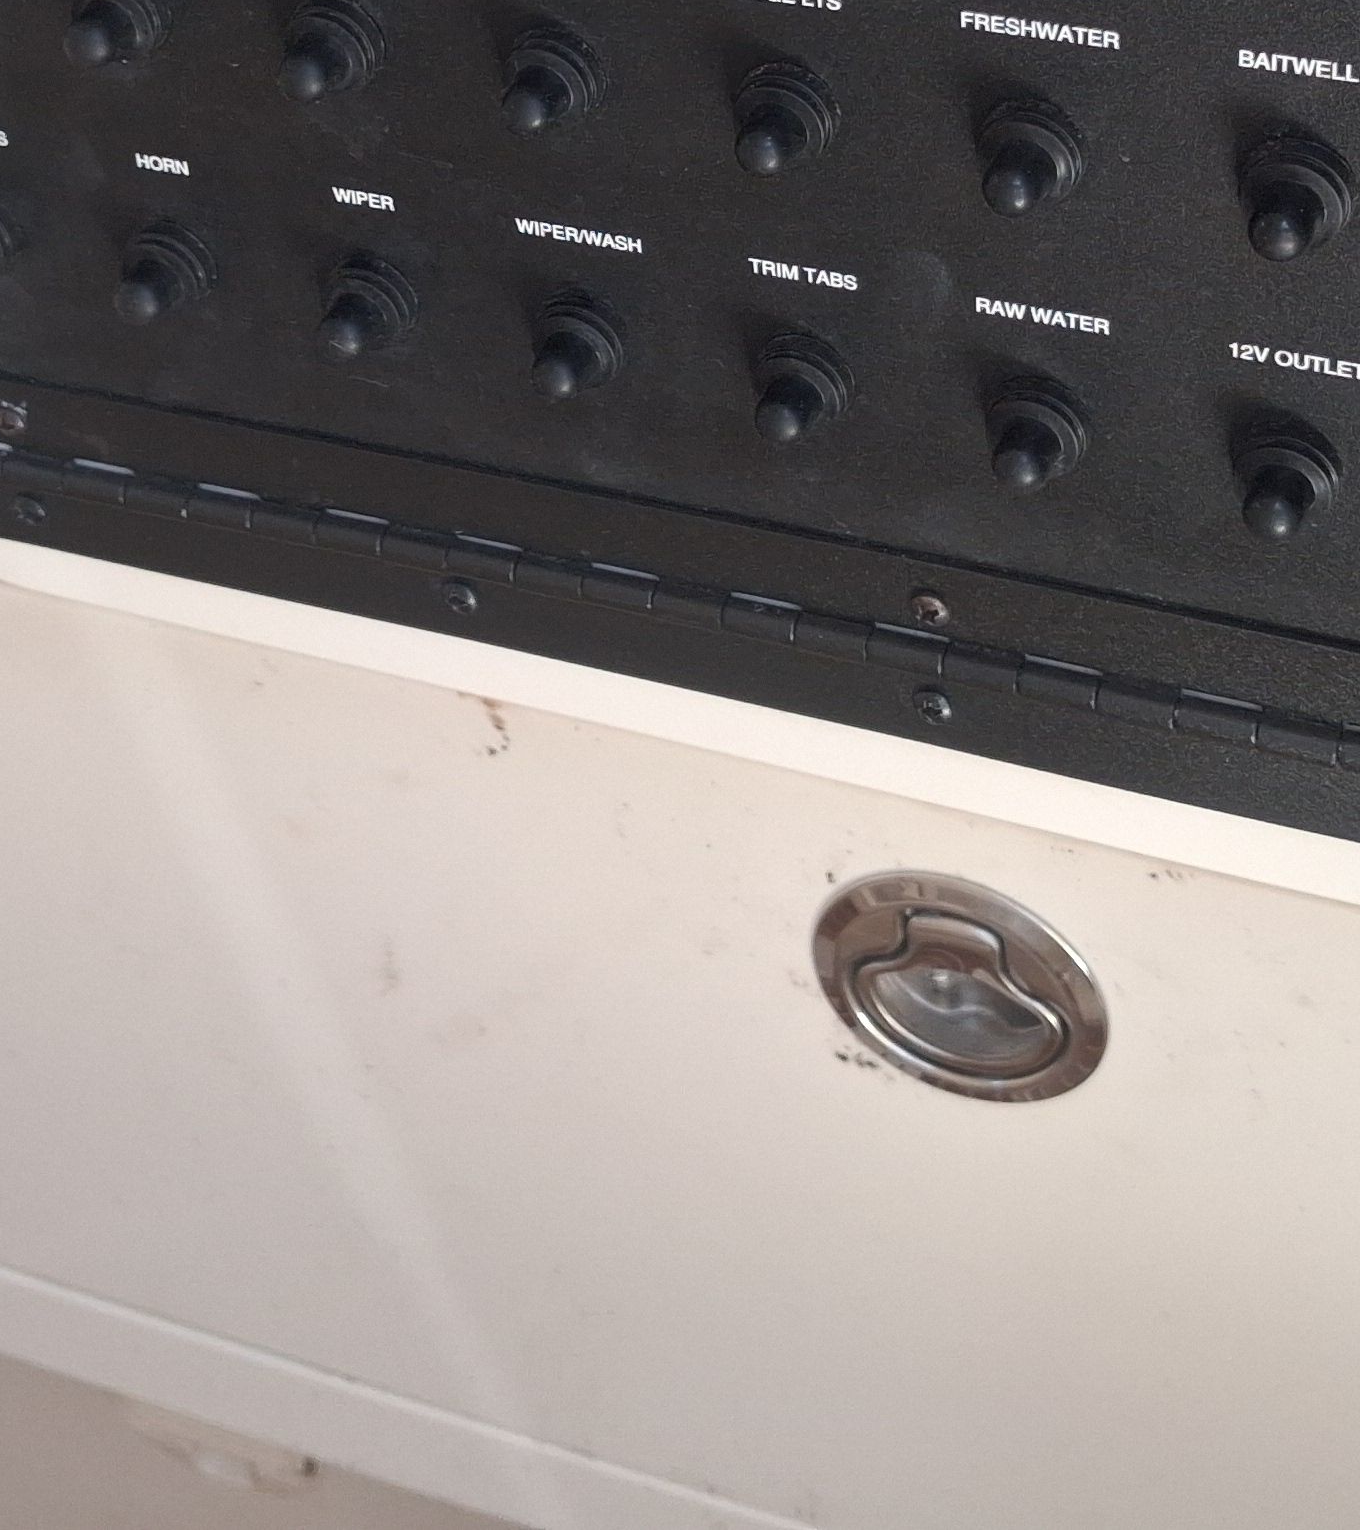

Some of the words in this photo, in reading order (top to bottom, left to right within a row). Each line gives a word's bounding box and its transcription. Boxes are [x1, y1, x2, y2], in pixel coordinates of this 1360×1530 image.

[960, 10, 1120, 50] FRESHWATER
[1238, 49, 1360, 83] BAITWELL
[135, 152, 190, 176] HORN
[331, 186, 396, 212] WIPER
[514, 217, 643, 254] WIPER/WASH
[747, 257, 800, 281] TRIM
[802, 267, 858, 291] TABS
[975, 296, 1027, 320] RAW
[1030, 306, 1110, 336] WATER
[1228, 342, 1270, 363] 12V
